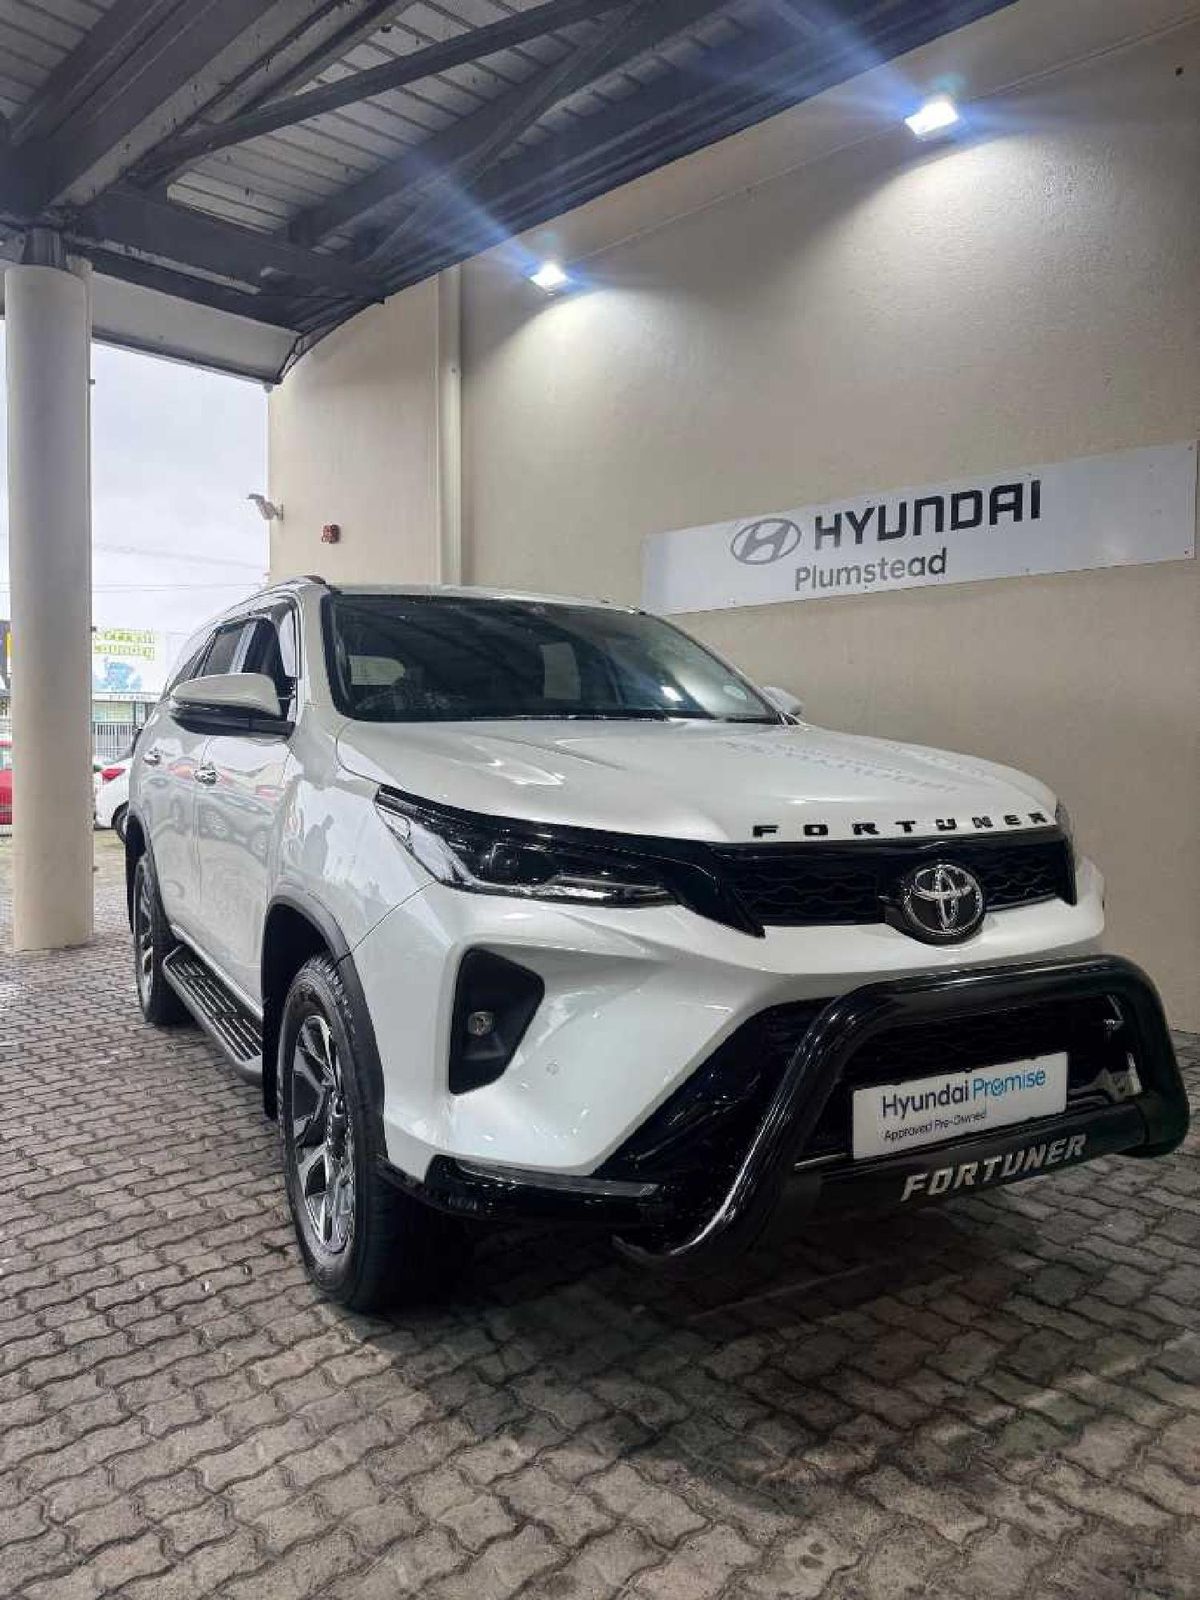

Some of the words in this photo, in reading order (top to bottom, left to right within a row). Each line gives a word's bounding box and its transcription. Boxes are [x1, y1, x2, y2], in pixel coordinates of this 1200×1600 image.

[814, 480, 1041, 550] HYUNDAI
[795, 548, 947, 591] Plumstead
[752, 812, 1047, 838] FORTUNER
[882, 1080, 969, 1119] Hyundai
[972, 1068, 1046, 1100] Promise
[884, 1122, 932, 1142] Approved
[934, 1111, 987, 1131] Pre-Owned
[901, 1134, 1087, 1202] FORTUNER
